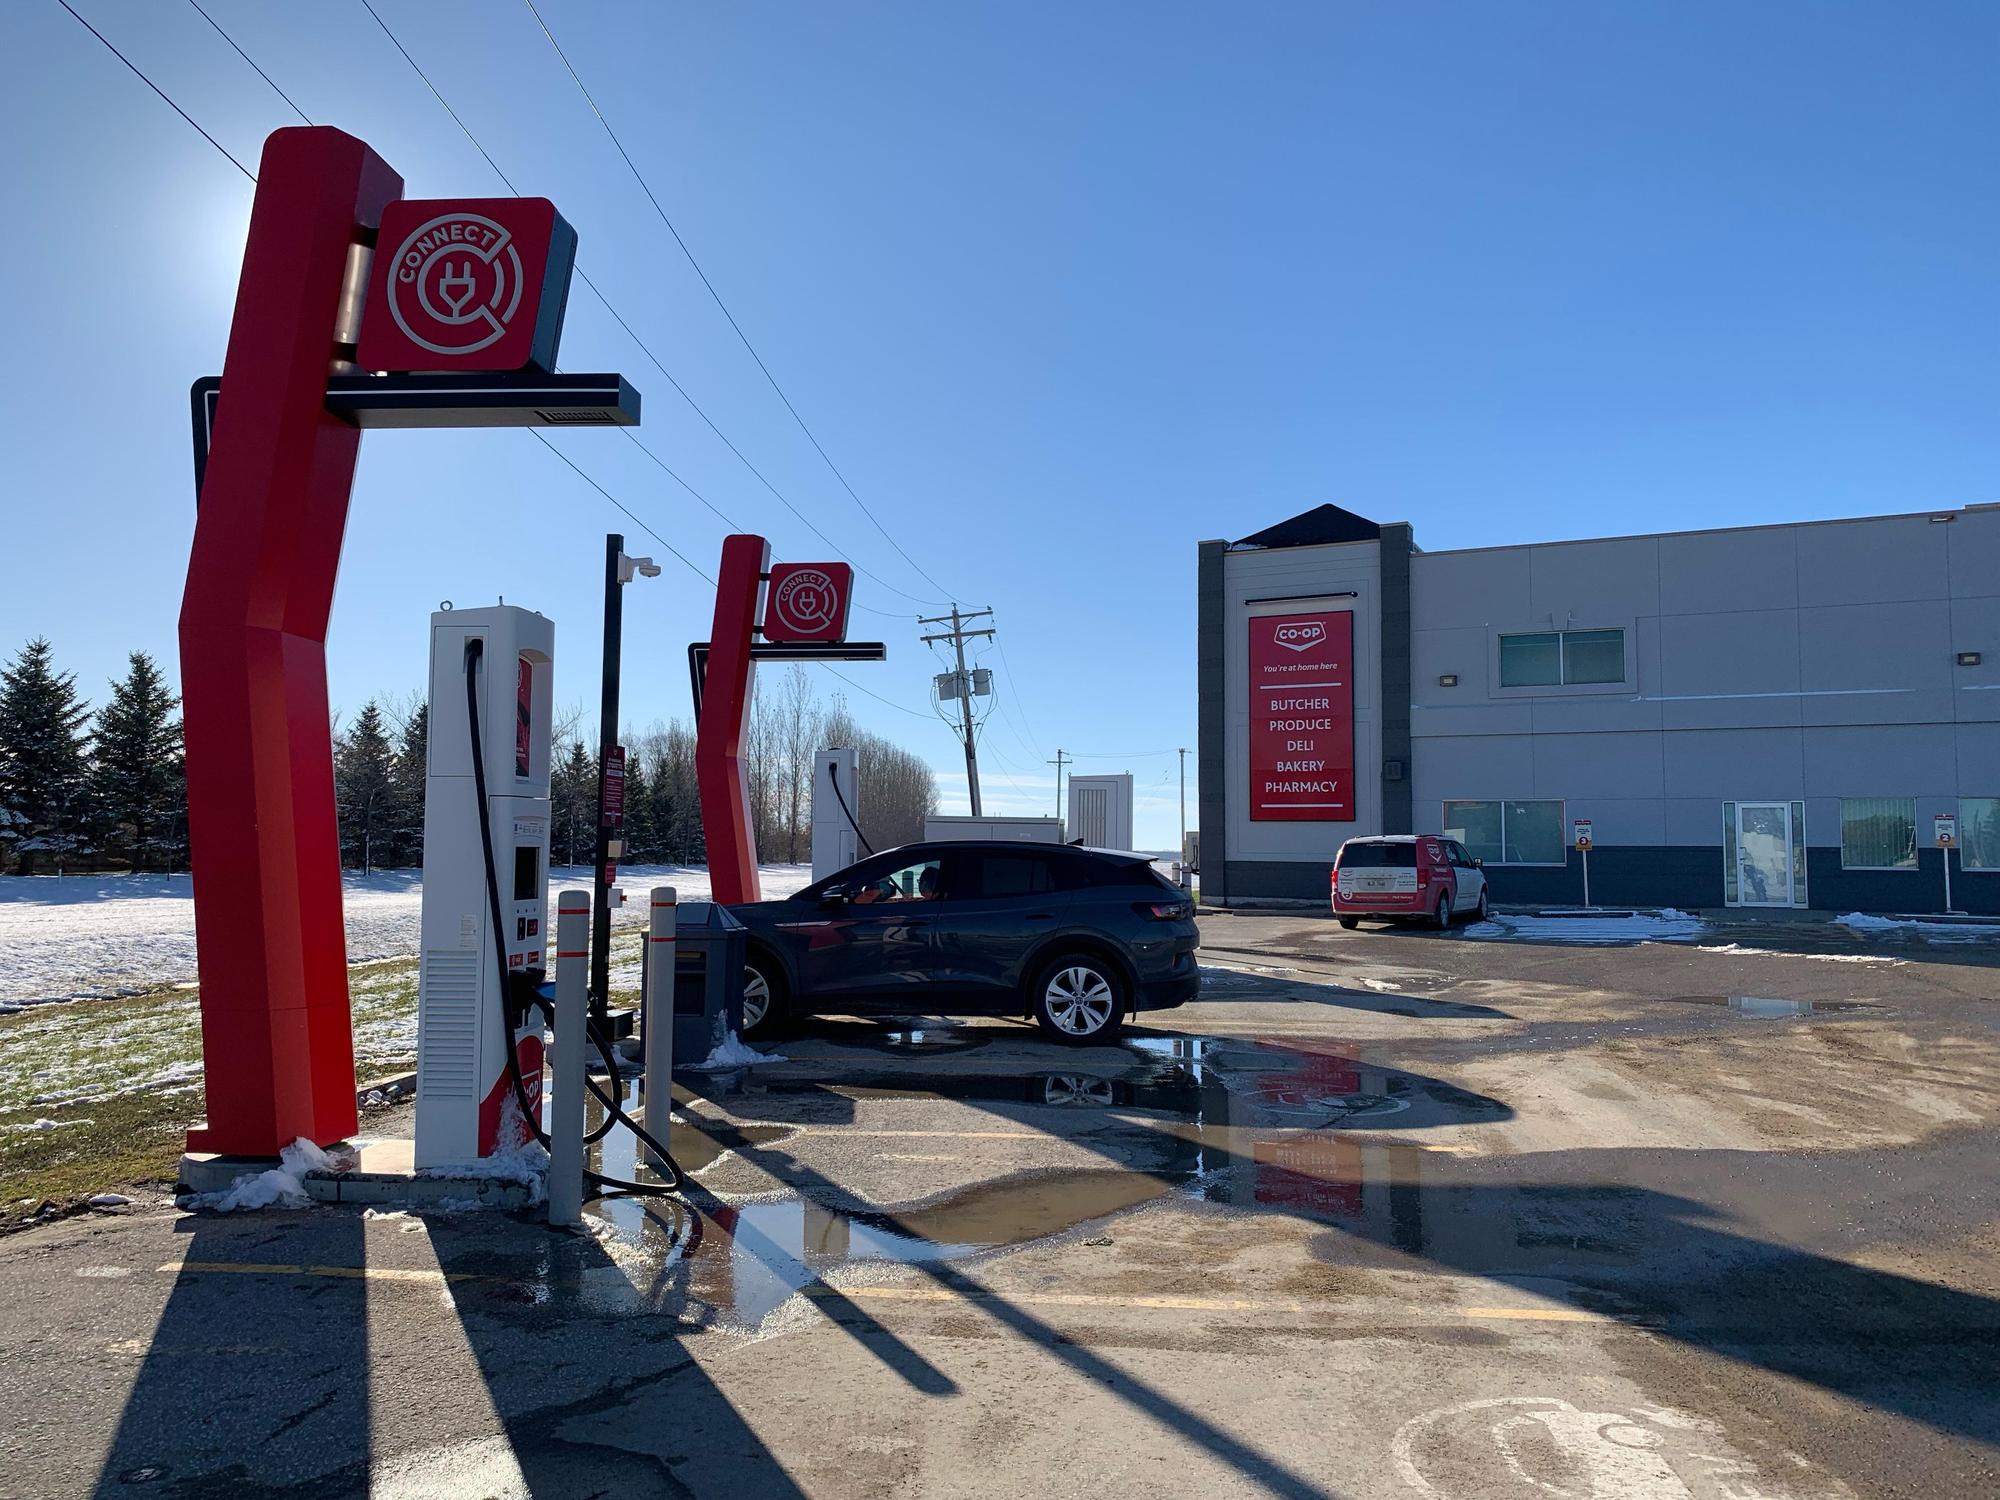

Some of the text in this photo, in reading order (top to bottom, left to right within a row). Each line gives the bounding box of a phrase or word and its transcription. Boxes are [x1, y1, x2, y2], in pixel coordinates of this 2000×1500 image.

[399, 224, 497, 284] CONNECT
[781, 574, 824, 602] CONNECT
[1279, 627, 1321, 640] CO-OP
[1263, 664, 1288, 673] You're
[1297, 663, 1319, 671] home
[1319, 662, 1338, 670] here
[1271, 698, 1330, 711] BUTCHER
[1269, 719, 1332, 732] PRODUCE
[1287, 740, 1314, 751] DELI
[1276, 760, 1325, 772] BAKERY
[1265, 781, 1338, 793] PHARMACY
